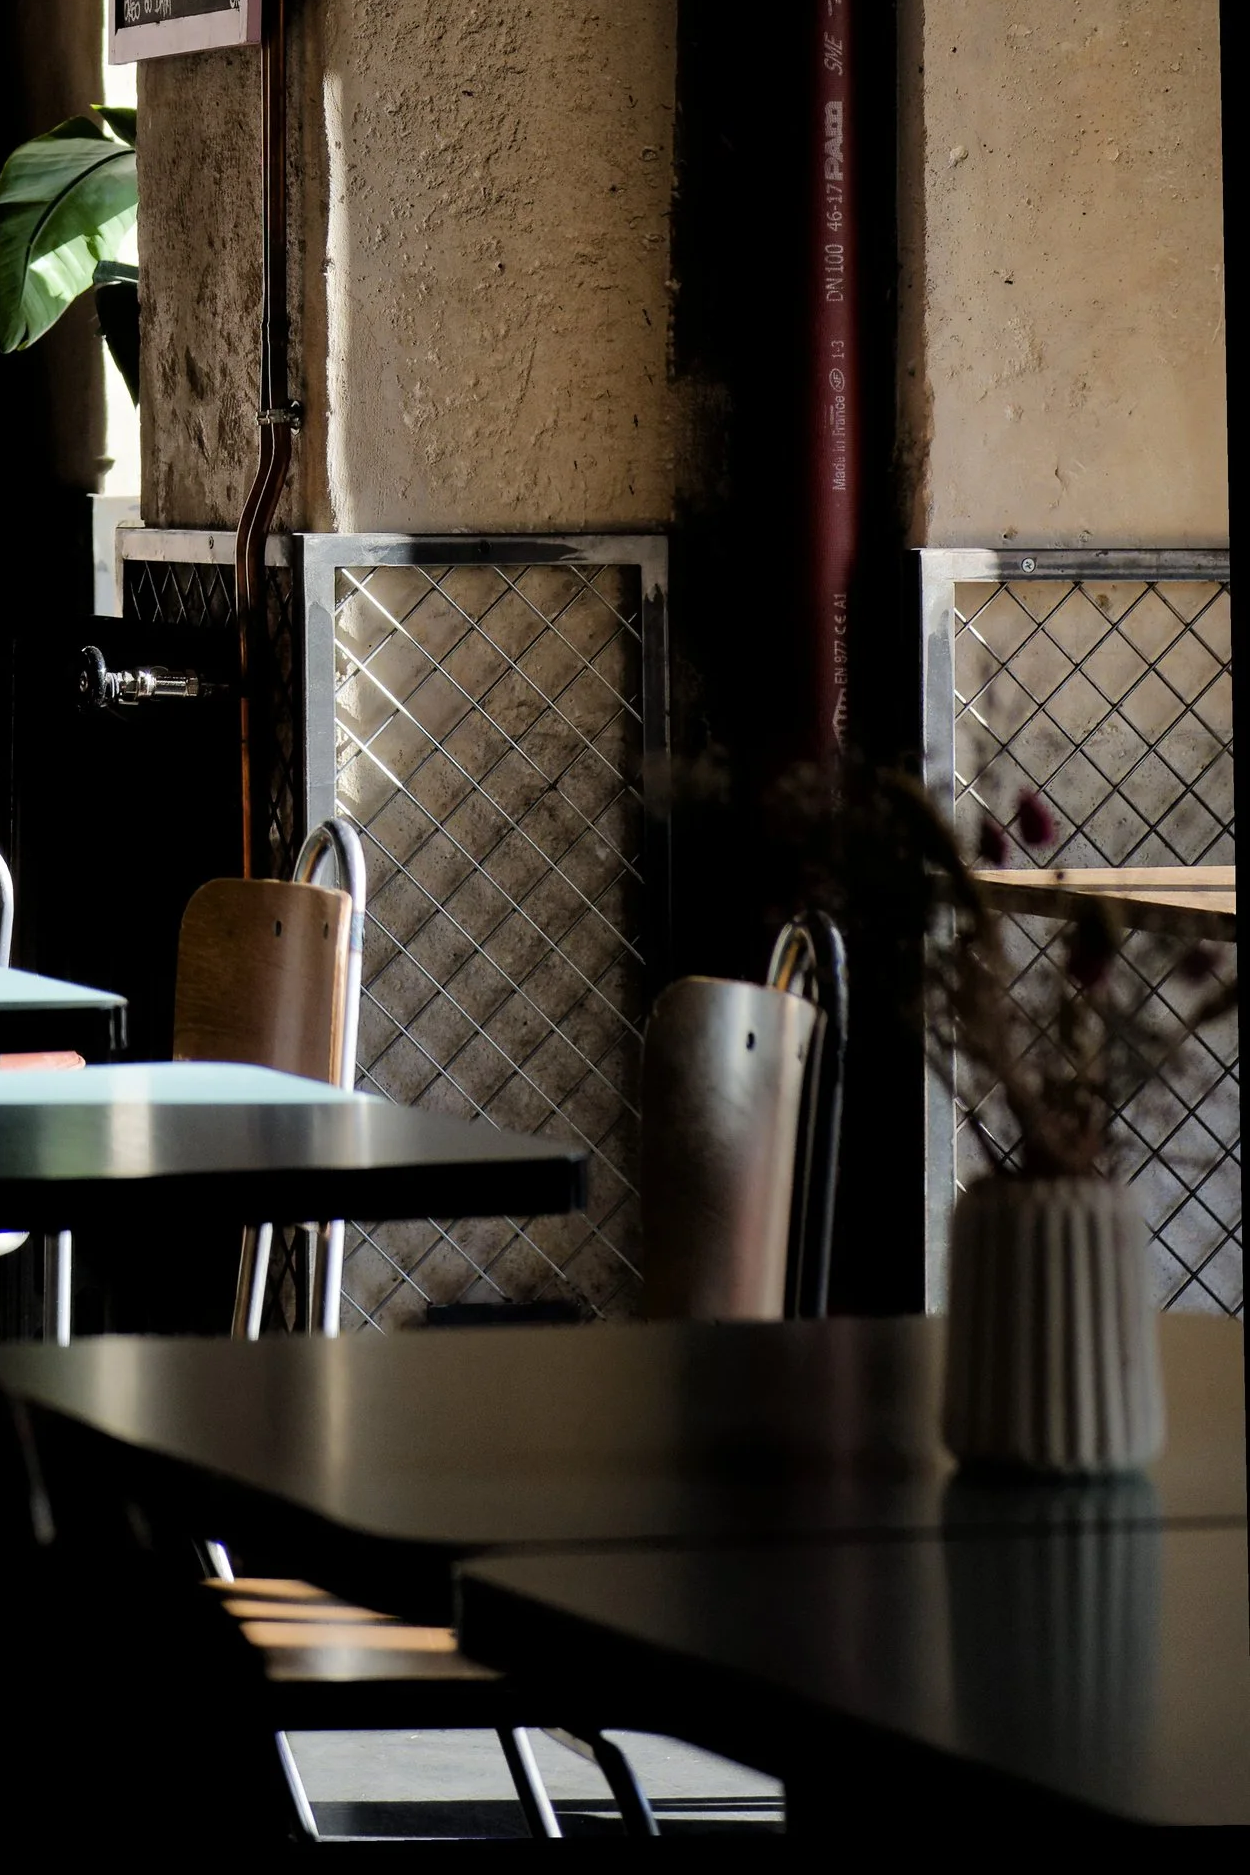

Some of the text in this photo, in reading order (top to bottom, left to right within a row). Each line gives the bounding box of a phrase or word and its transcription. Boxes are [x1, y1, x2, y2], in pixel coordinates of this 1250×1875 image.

[823, 32, 844, 77] SME
[826, 183, 843, 232] 46-17
[825, 243, 844, 273] 100
[826, 278, 844, 302] DN
[832, 340, 845, 359] 1-3
[831, 395, 846, 437] France
[832, 441, 846, 452] in
[833, 456, 846, 490] Made
[834, 593, 847, 609] A1
[834, 668, 848, 685] EN
